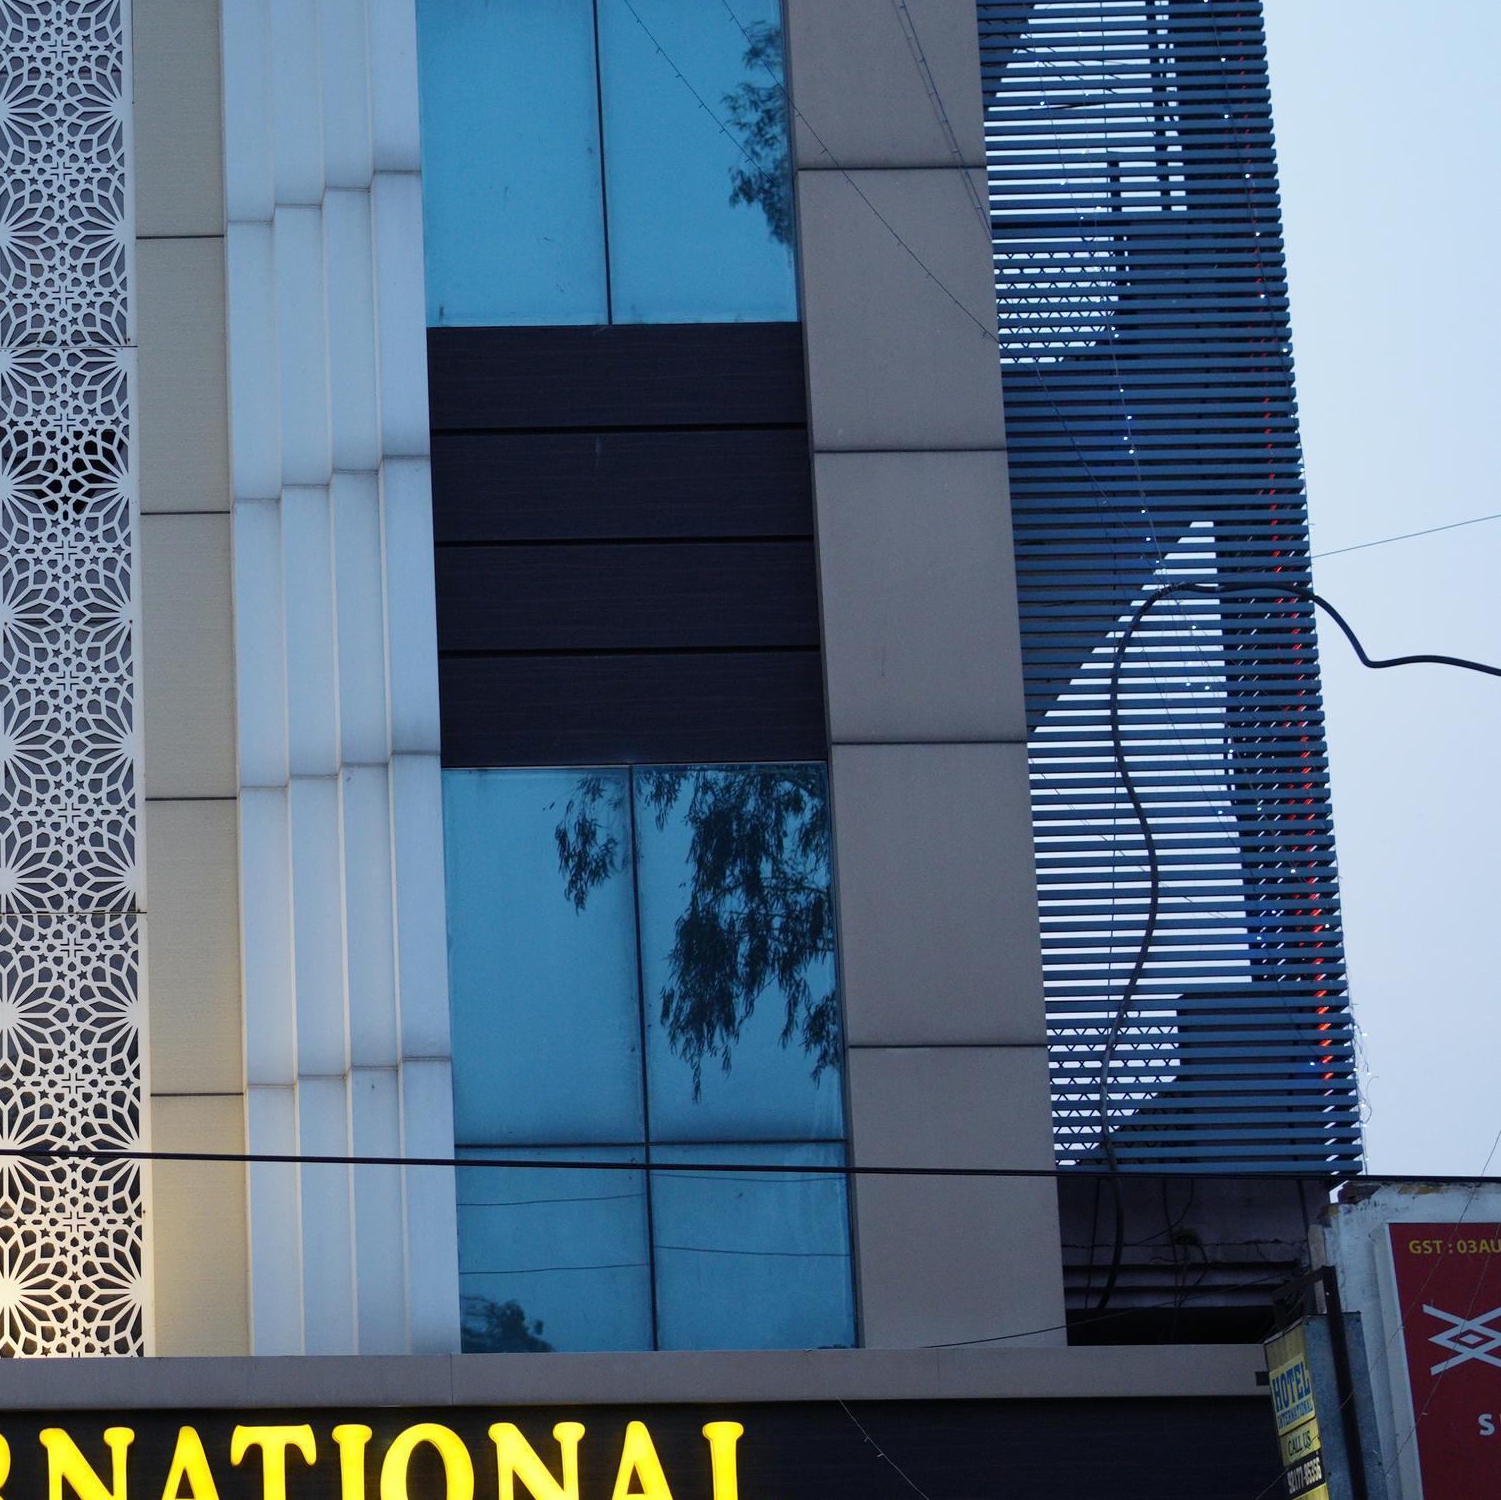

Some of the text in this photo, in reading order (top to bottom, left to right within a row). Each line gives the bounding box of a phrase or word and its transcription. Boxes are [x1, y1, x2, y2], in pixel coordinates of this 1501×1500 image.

[1409, 1240, 1443, 1254] GST
[1272, 1362, 1311, 1413] HOTEL
[1287, 1435, 1303, 1457] CALL
